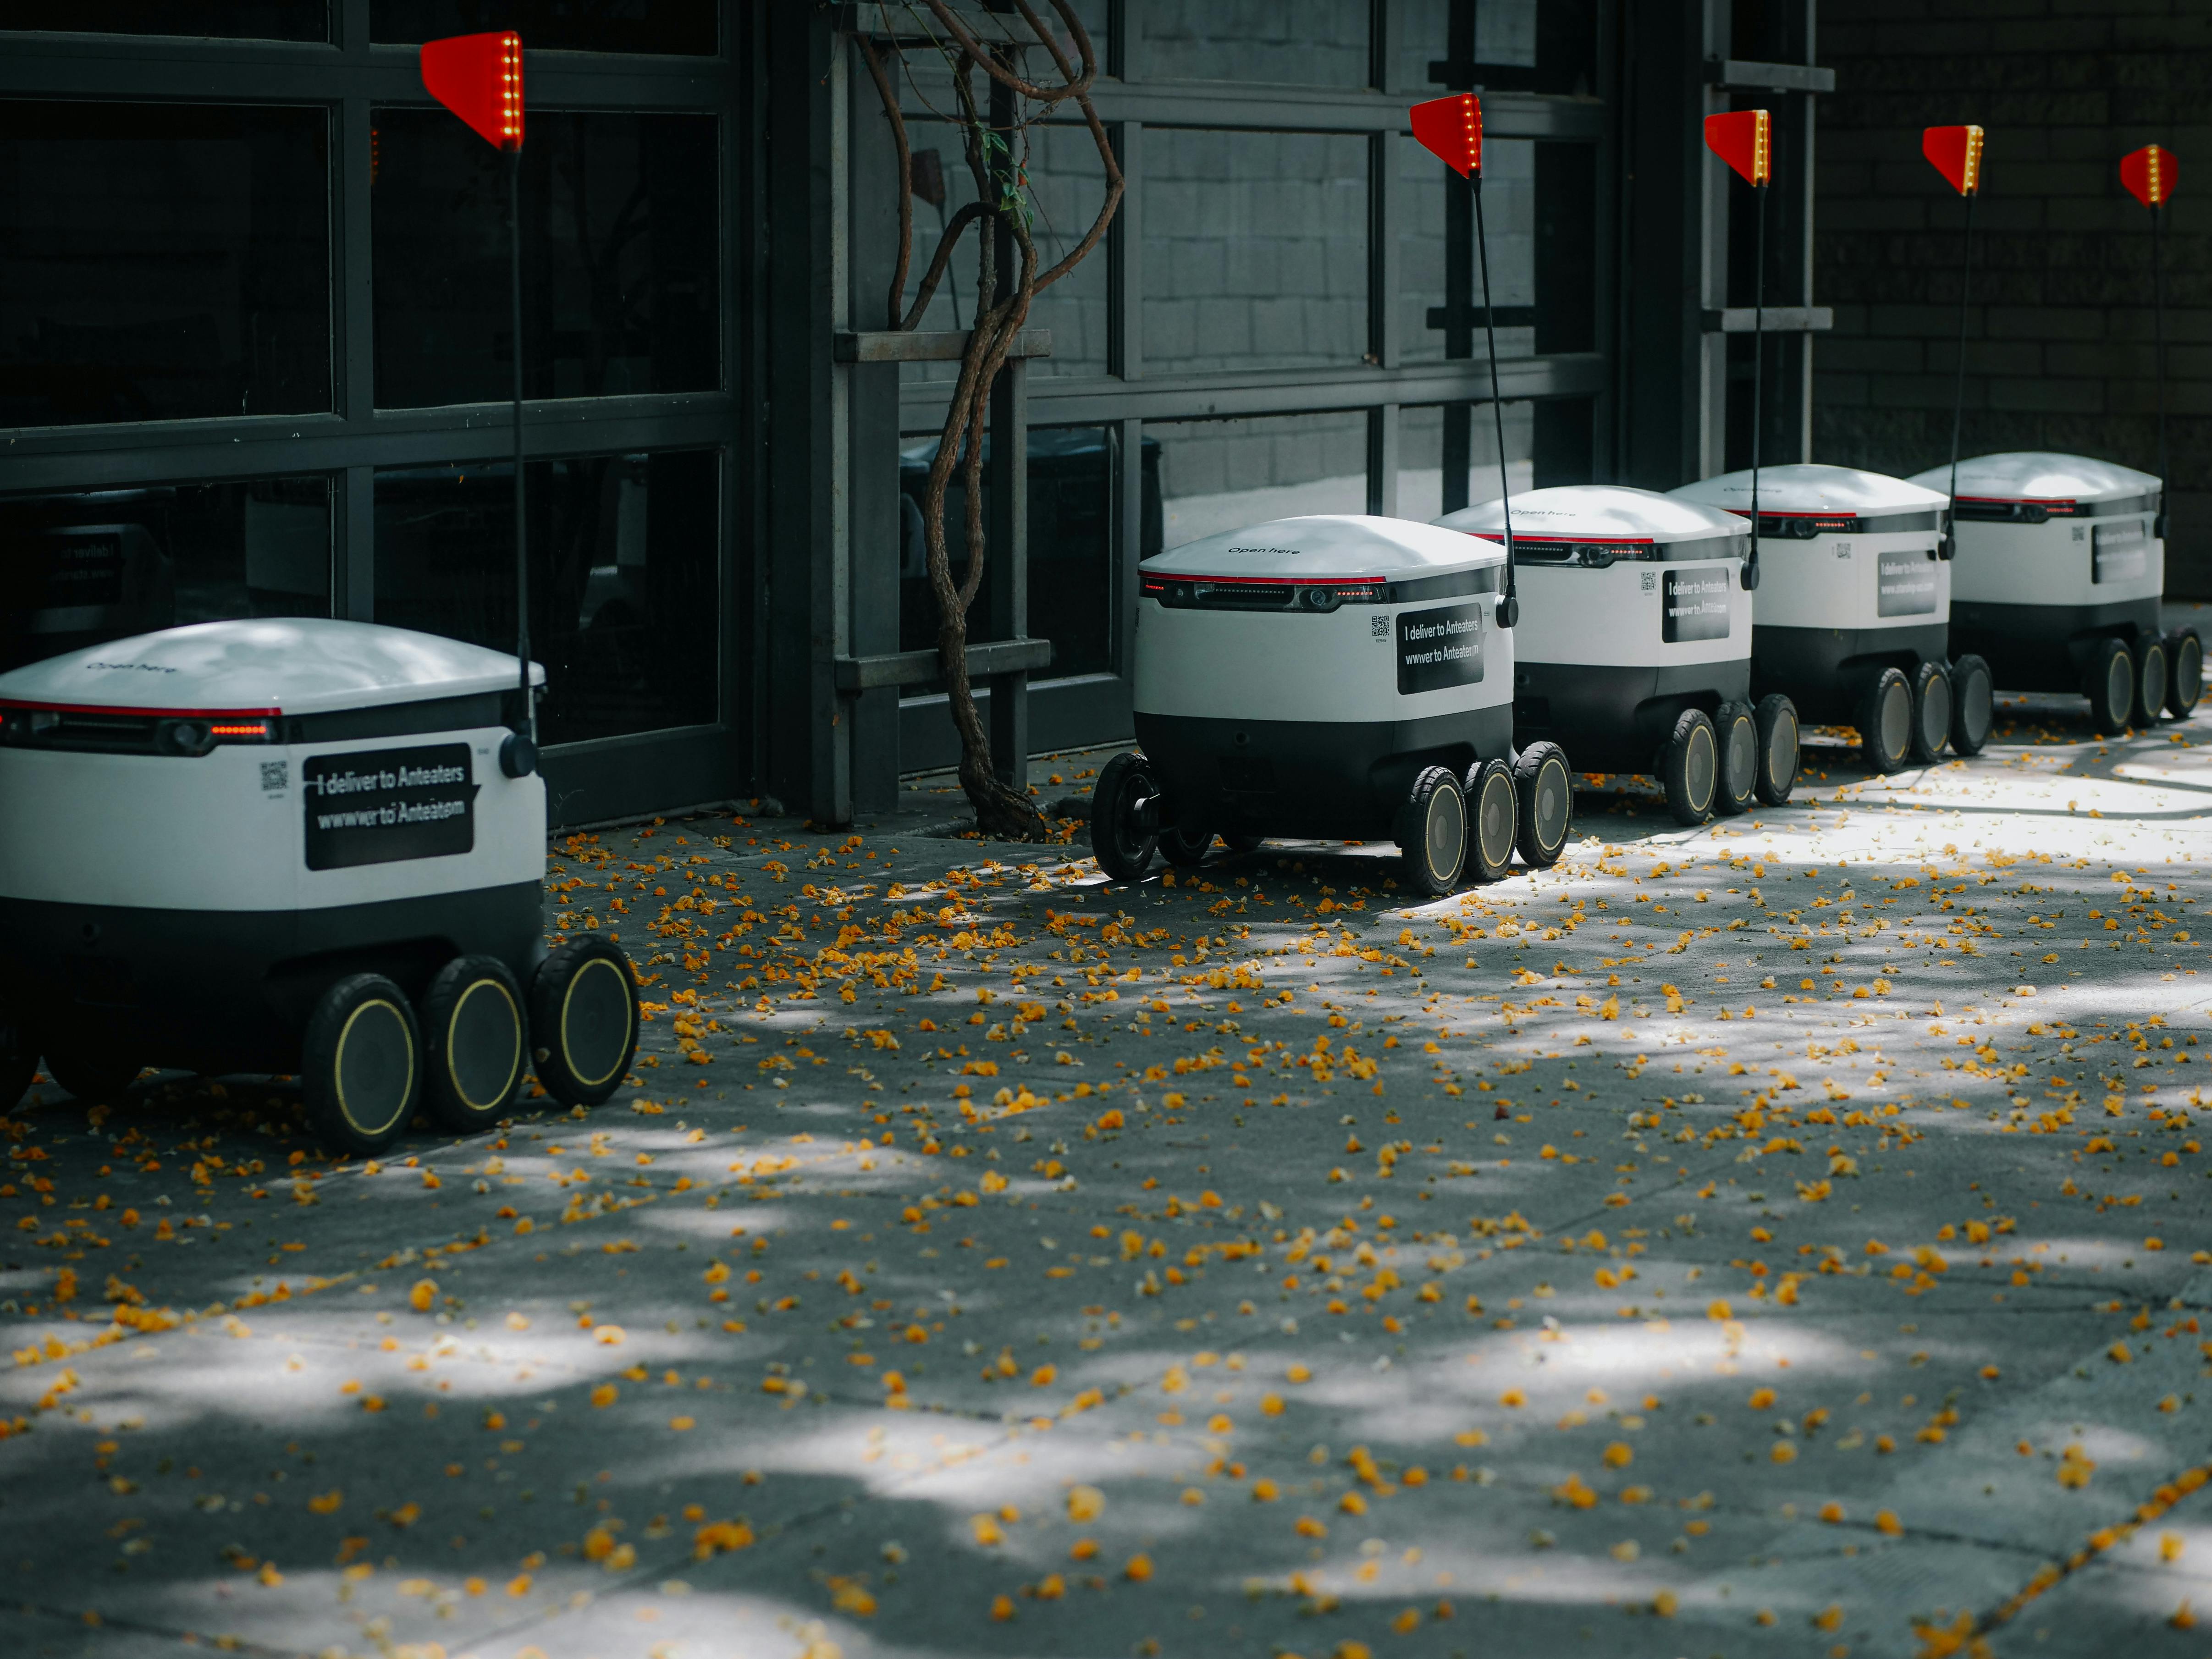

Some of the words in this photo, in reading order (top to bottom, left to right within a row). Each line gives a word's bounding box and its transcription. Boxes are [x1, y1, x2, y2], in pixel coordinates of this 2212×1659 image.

[1669, 582, 1672, 595] I
[1673, 581, 1693, 595] deliver
[1694, 582, 1700, 594] to
[1701, 580, 1727, 593] Anteaters
[1694, 604, 1700, 614] to
[1405, 626, 1408, 641] I
[1410, 624, 1435, 640] deliver
[1437, 623, 1445, 636] to
[1446, 619, 1478, 635] Anteaters
[1434, 649, 1442, 662] to
[136, 663, 177, 673] here
[317, 774, 324, 795] I
[327, 771, 378, 795] deliver
[380, 770, 396, 789] to
[397, 766, 464, 787] Anteaters
[380, 806, 396, 825] to
